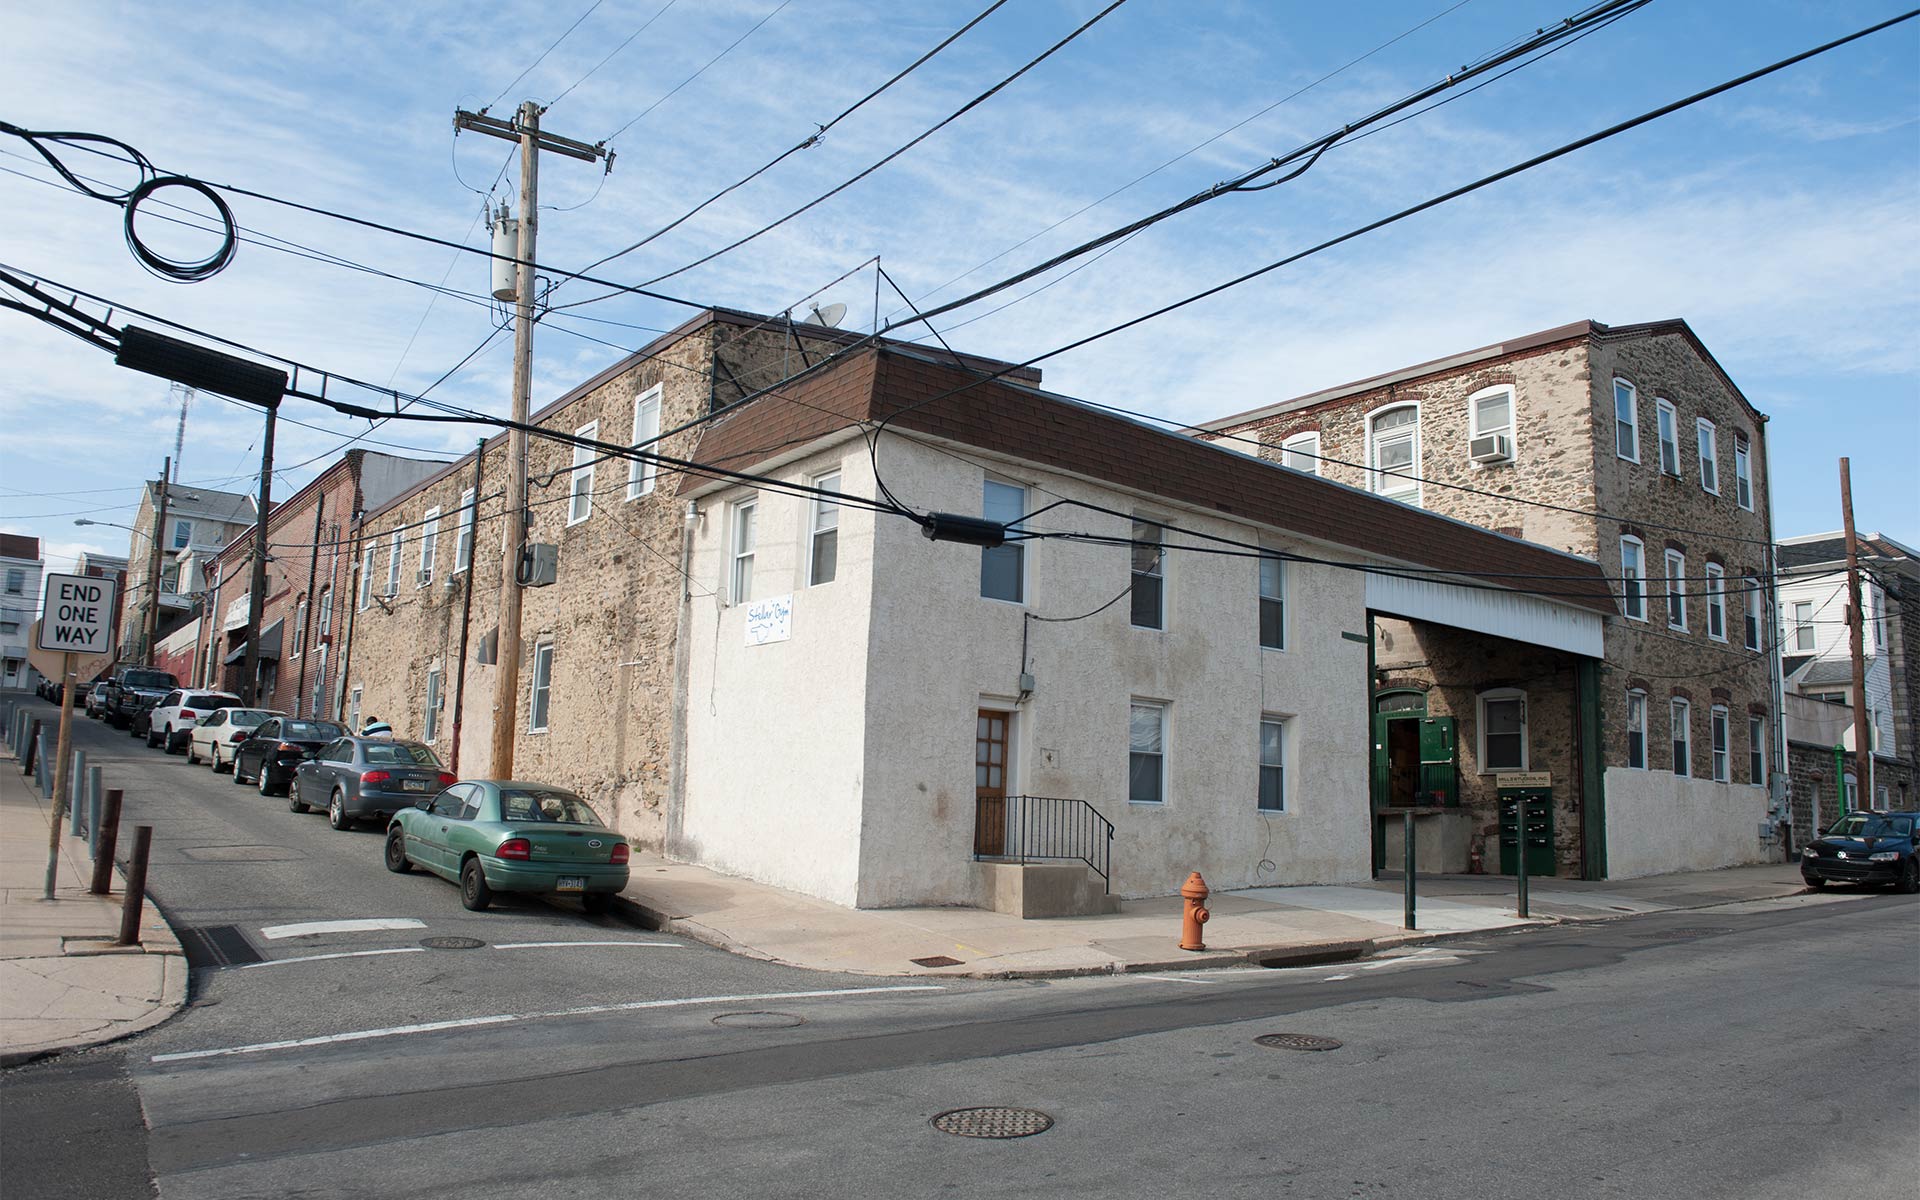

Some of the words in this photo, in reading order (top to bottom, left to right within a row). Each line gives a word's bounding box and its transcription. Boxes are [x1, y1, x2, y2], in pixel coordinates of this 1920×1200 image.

[60, 583, 101, 603] END
[58, 605, 98, 624] ONE
[55, 625, 99, 645] WAY
